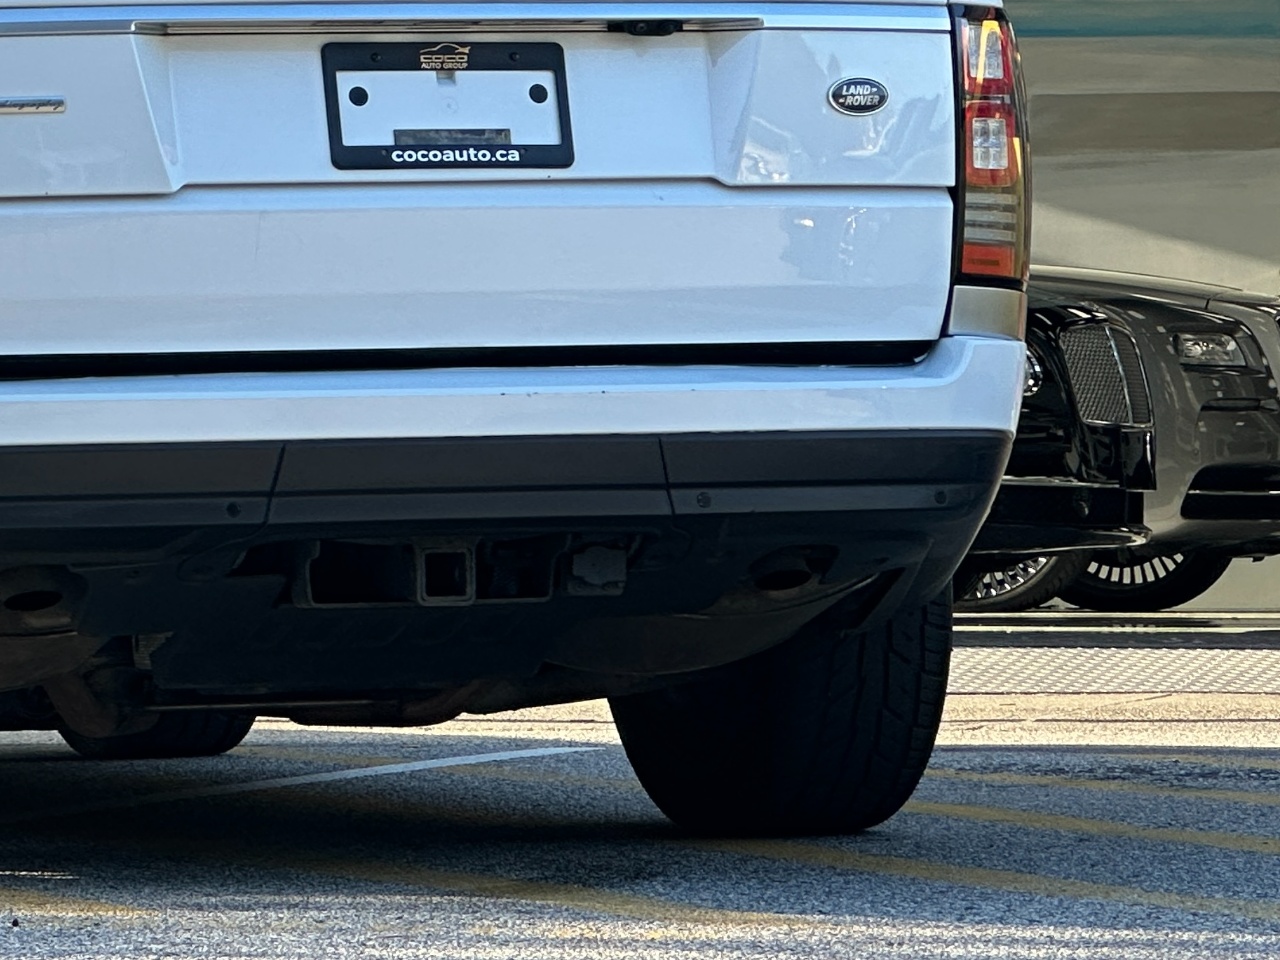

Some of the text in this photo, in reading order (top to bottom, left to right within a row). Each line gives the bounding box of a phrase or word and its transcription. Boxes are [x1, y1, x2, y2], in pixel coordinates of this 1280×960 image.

[842, 85, 871, 95] LAND
[845, 95, 880, 106] ROVER
[391, 147, 520, 162] cocoauto.ca
